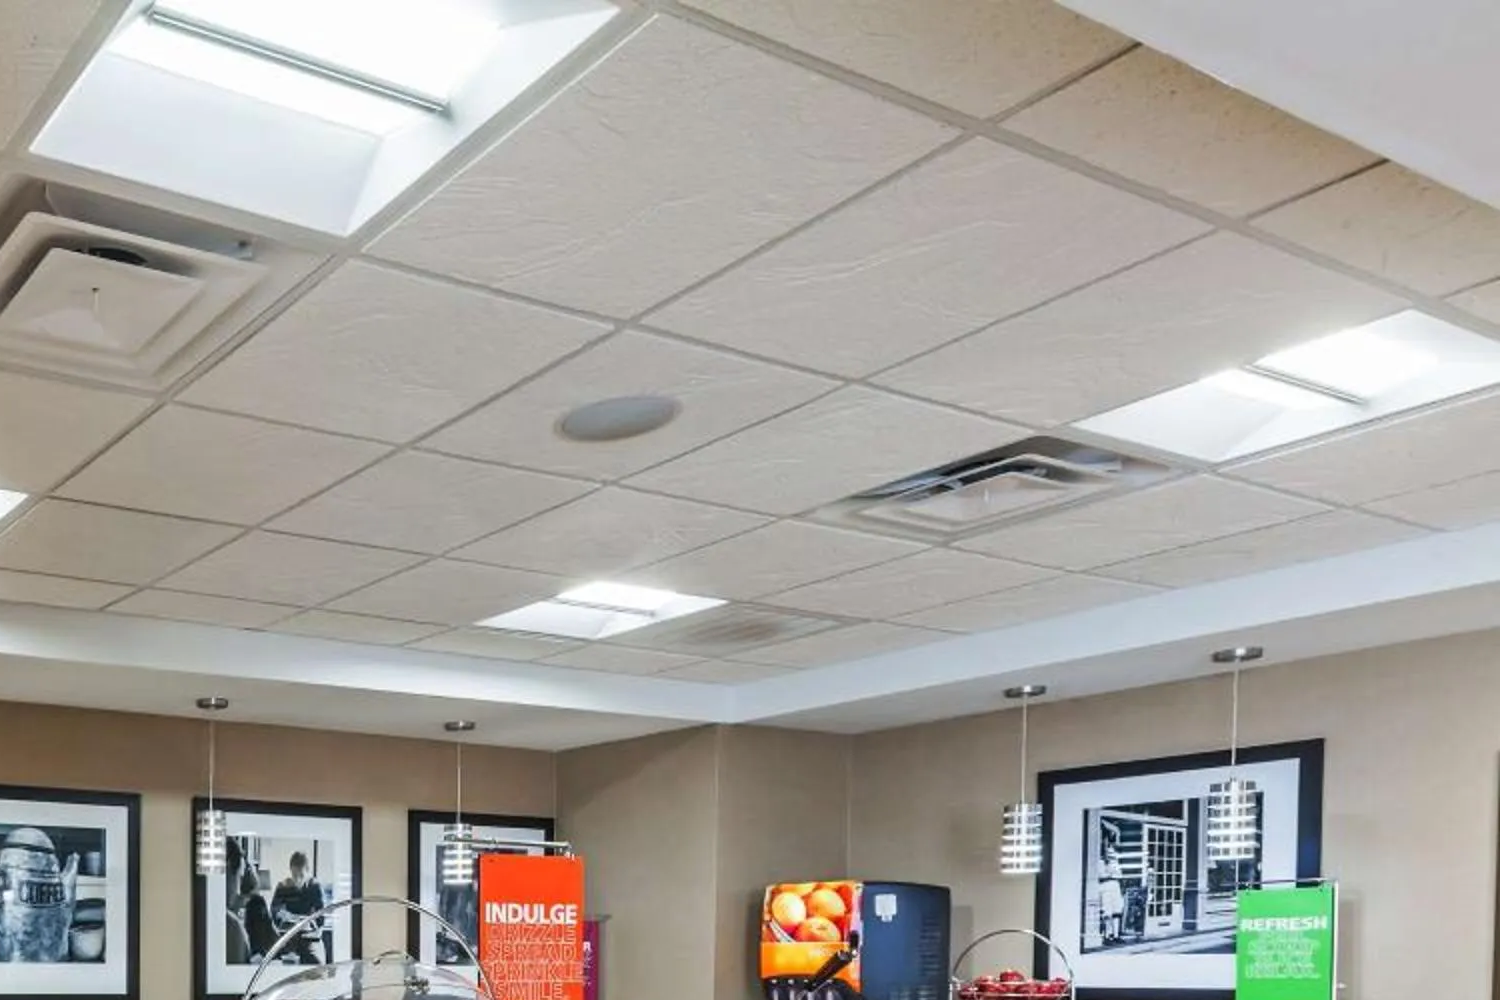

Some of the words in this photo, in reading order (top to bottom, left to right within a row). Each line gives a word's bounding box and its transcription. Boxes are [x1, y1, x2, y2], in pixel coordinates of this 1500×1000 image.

[485, 903, 577, 923] INDULGE
[489, 923, 576, 944] DRIZZLE
[1240, 916, 1327, 931] REFRESH
